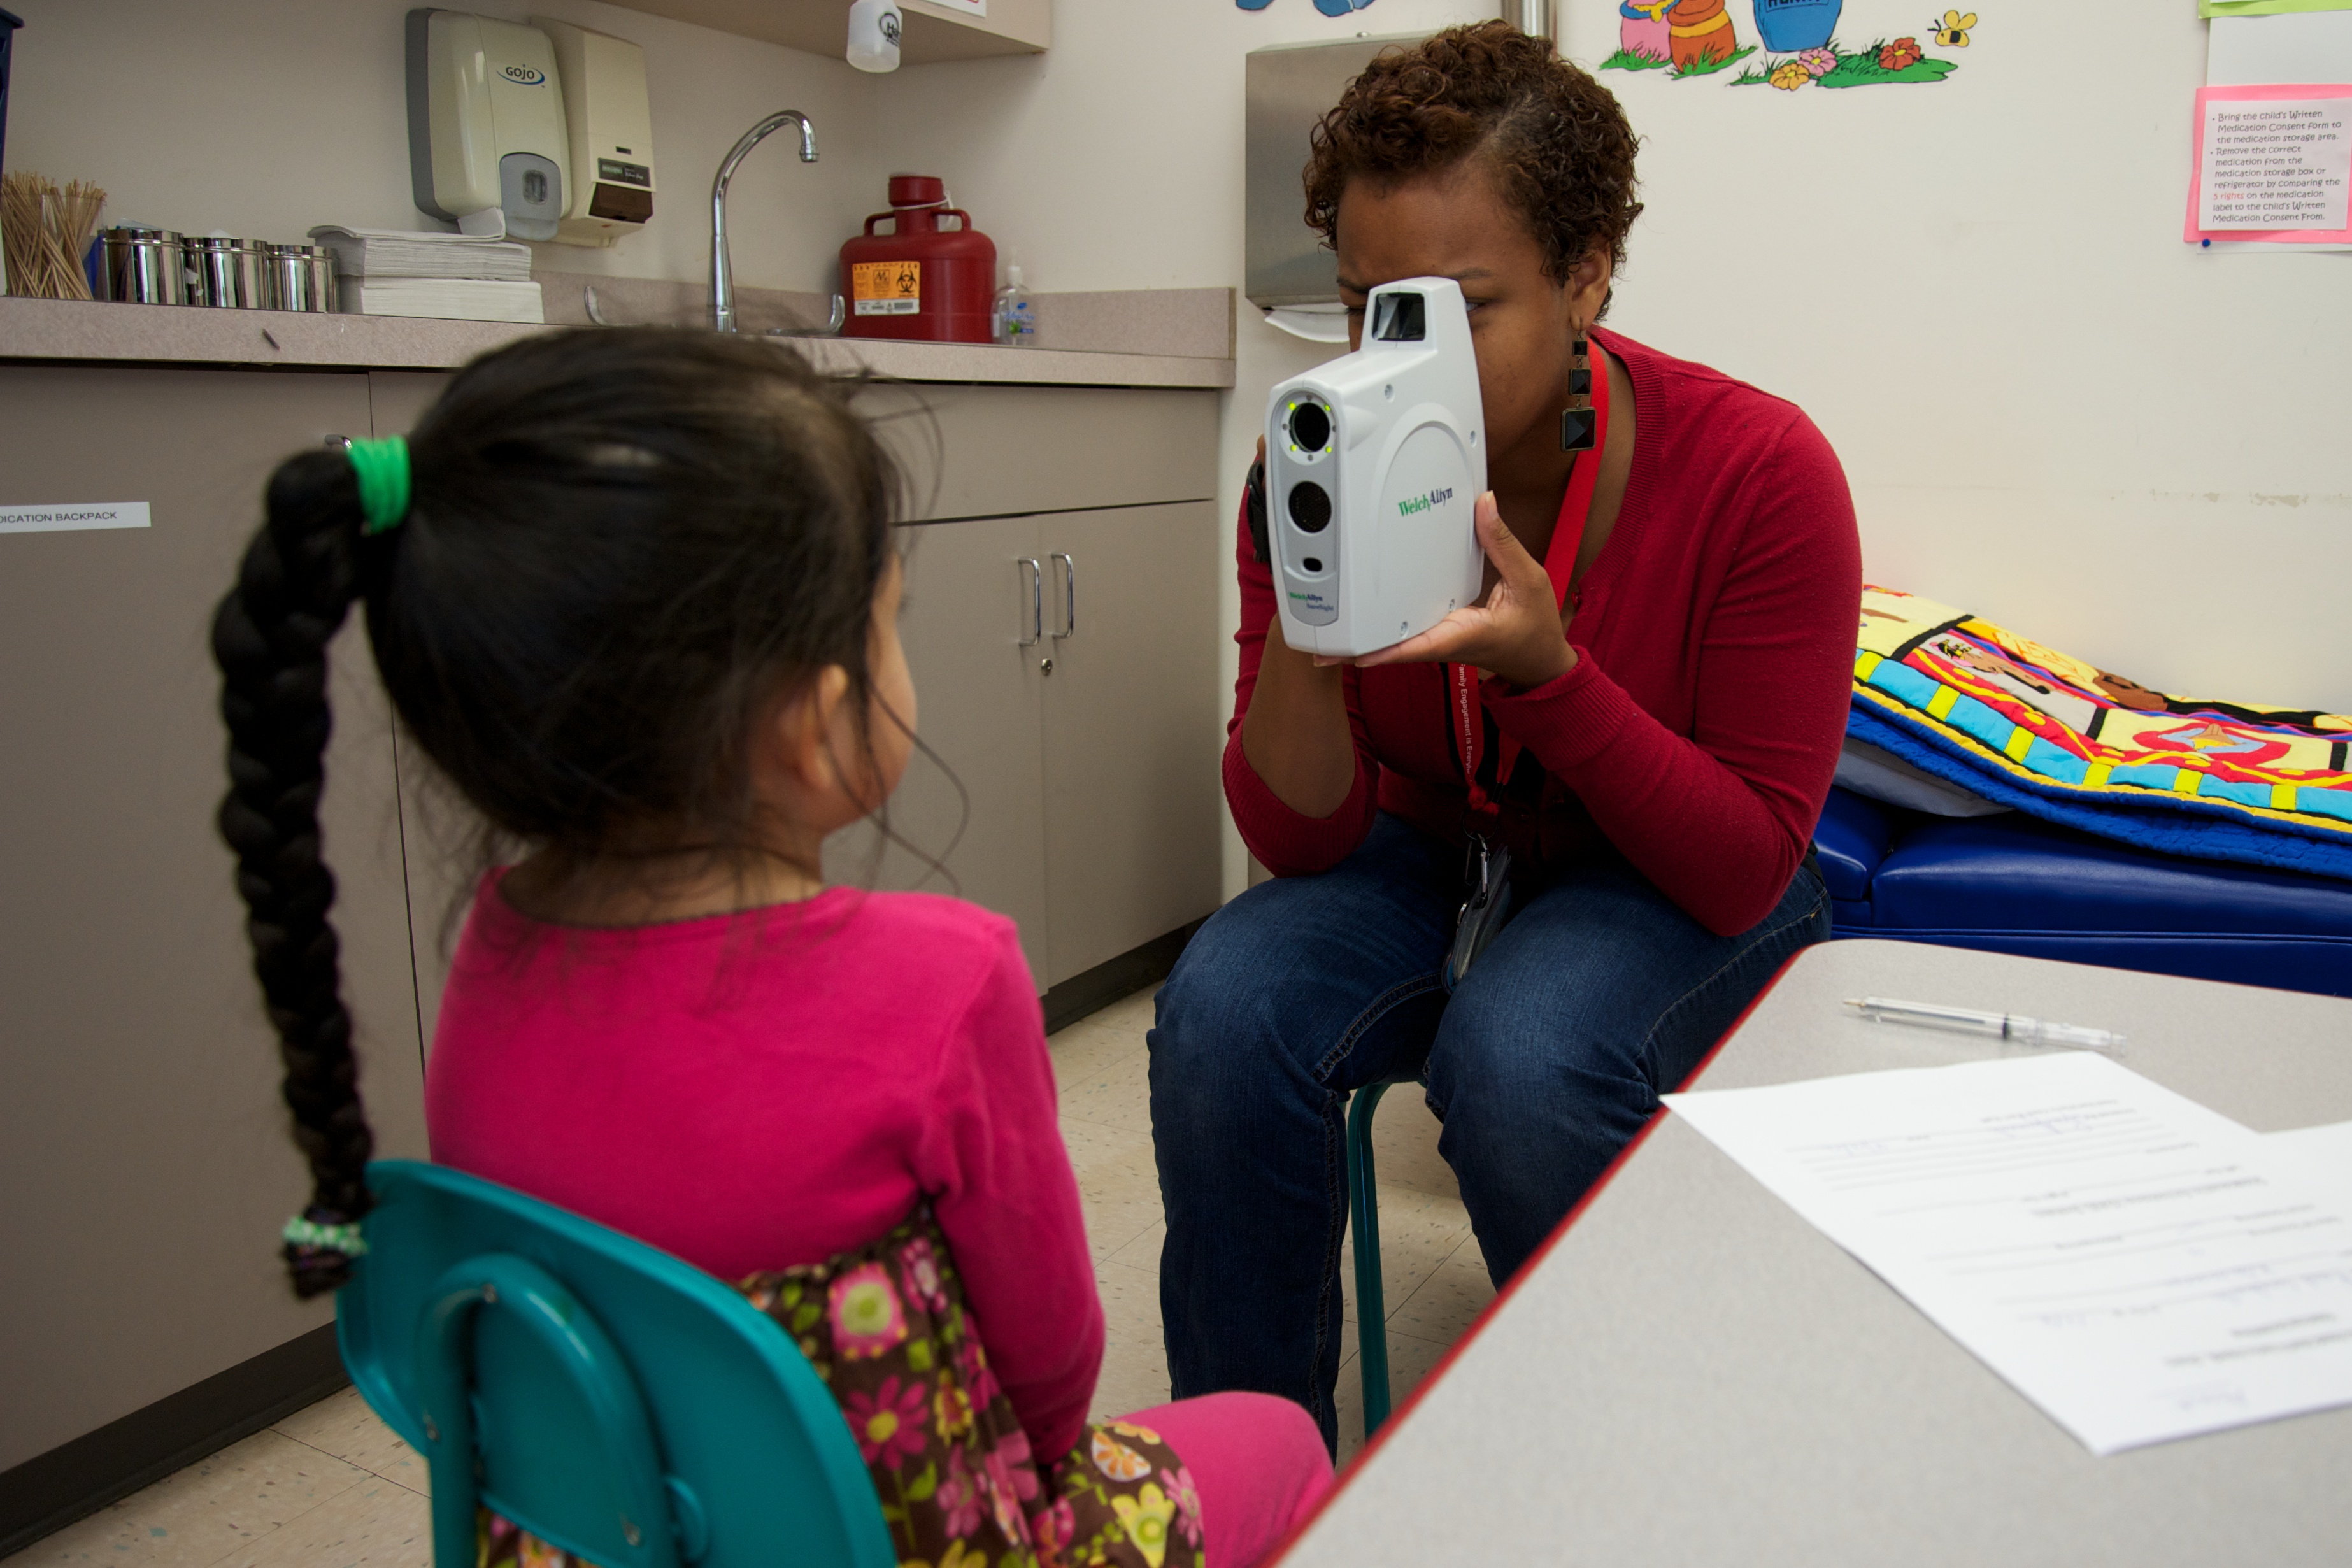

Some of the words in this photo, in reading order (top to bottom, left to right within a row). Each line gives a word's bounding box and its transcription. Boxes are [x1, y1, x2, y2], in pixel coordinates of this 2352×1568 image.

[2218, 113, 2241, 122] Bring
[2289, 110, 2323, 120] Written
[2218, 124, 2267, 133] Medication
[2269, 123, 2306, 132] Consent
[2234, 135, 2281, 143] medication
[2283, 134, 2315, 142] storage
[2216, 147, 2249, 155] Remove
[2216, 158, 2262, 167] medication
[2264, 158, 2286, 166] from
[2215, 169, 2262, 178] medication
[2298, 167, 2314, 176] box
[2214, 180, 2265, 190] refrigerator
[2267, 180, 2277, 189] by
[2278, 179, 2323, 188] comparing
[2220, 192, 2244, 201] rights
[2276, 190, 2324, 199] medication
[2292, 201, 2326, 211] Written
[2213, 214, 2261, 223] Medication
[2263, 213, 2299, 223] Consent
[2301, 213, 2325, 222] From.
[55, 511, 117, 522] BACKPACK
[1460, 688, 1472, 736] Engagement
